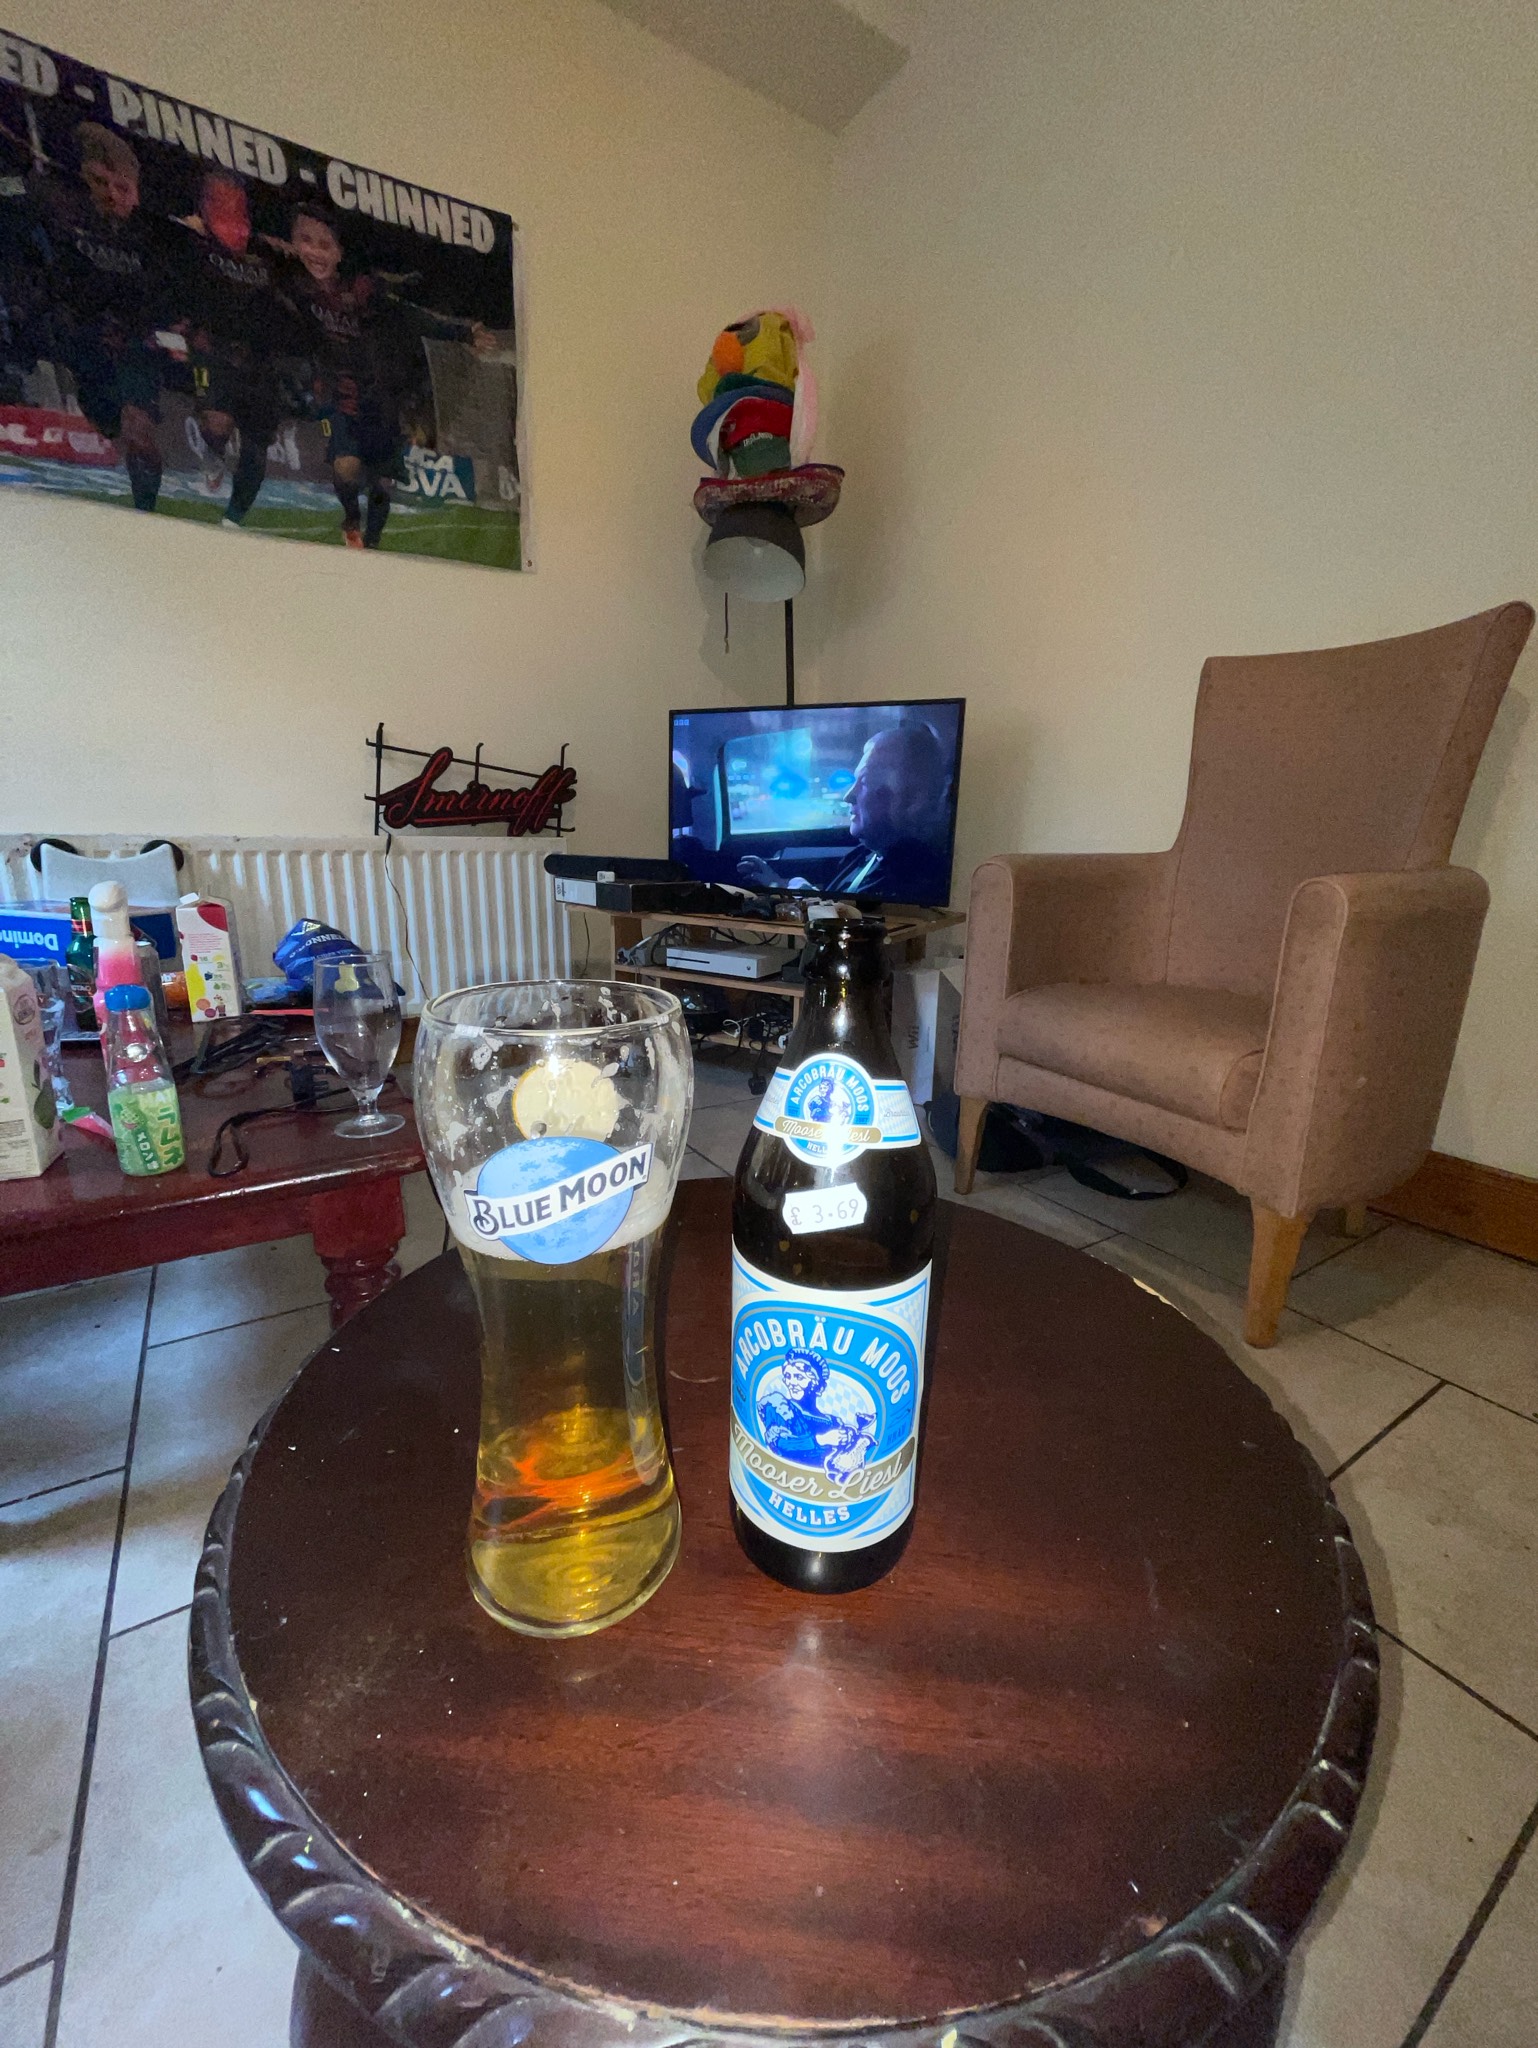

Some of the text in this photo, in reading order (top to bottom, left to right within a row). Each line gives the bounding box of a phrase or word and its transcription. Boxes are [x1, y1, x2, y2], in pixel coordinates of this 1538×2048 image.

[106, 77, 288, 186] PINNED
[326, 158, 495, 254] CHINNED
[380, 746, 577, 837] Smirnoff
[0, 930, 59, 951] Domin
[846, 1076, 869, 1112] MOOS
[157, 1106, 183, 1165] ラムネ
[473, 1152, 647, 1235] BLUE MOON
[735, 1315, 911, 1405] ARCOBRÄU MOOS
[734, 1421, 824, 1498] Mooser
[828, 1451, 904, 1502] Liesl
[768, 1489, 851, 1526] HELLES
